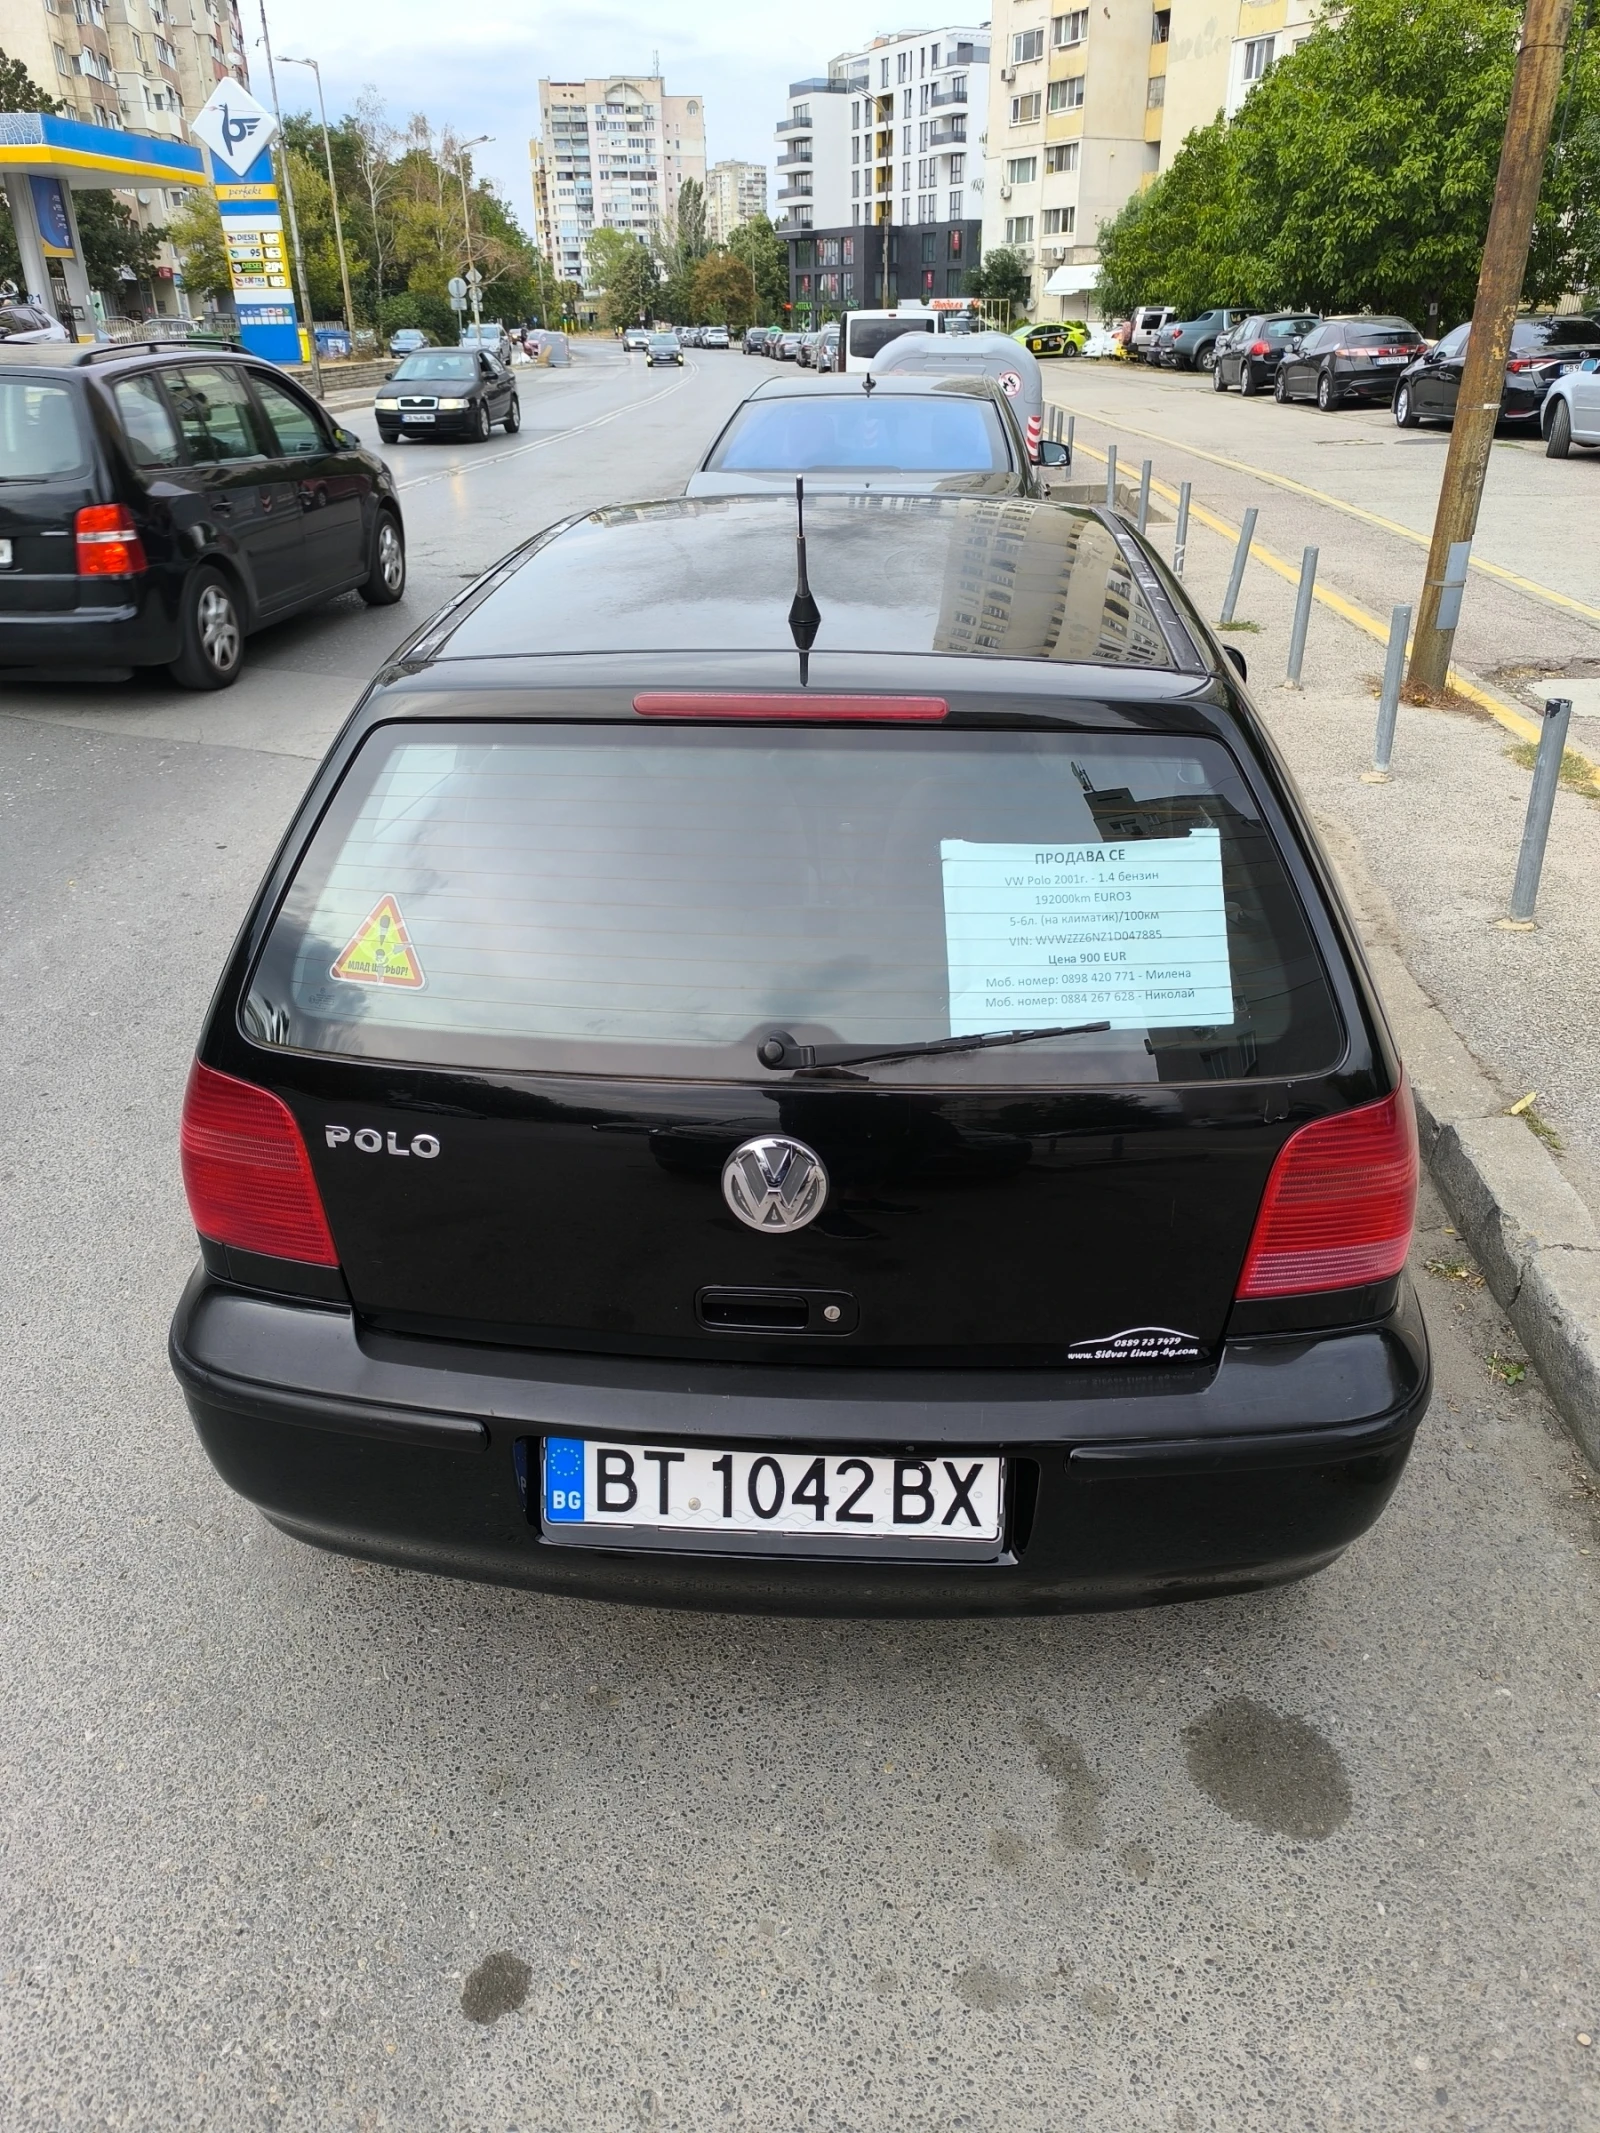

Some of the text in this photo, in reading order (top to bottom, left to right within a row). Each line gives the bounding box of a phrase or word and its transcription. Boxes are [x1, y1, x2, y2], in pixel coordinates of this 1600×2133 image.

[237, 233, 258, 241] DIESEL
[250, 248, 261, 257] 95
[241, 262, 263, 270] DIESEL
[244, 276, 265, 284] EXTRA
[1034, 848, 1126, 866] ПРОДАВА СЕ
[1004, 876, 1024, 887] VW
[1027, 874, 1052, 886] Polo
[1054, 873, 1088, 885] 2001г.
[1098, 872, 1116, 883] 1.4
[1118, 870, 1160, 882] бензин
[1035, 891, 1132, 905] 192000km EURO3
[1009, 910, 1160, 927] 5-6л. (на климатик)/100км
[1009, 936, 1033, 947] VIN:
[1048, 951, 1127, 966] Цена 900 EUR
[347, 960, 370, 973] МЛАД
[985, 976, 1015, 988] Моб.
[1018, 976, 1059, 987] номер:
[1061, 973, 1089, 984] 0898
[1090, 972, 1112, 983] 420
[1114, 971, 1135, 982] 771
[1145, 969, 1192, 980] Милена
[985, 996, 1014, 1008] Моб.
[1017, 996, 1058, 1007] номер:
[1060, 993, 1088, 1005] 0884
[1090, 992, 1111, 1003] 267
[1114, 991, 1135, 1002] 628
[1145, 987, 1196, 1000] Николай
[324, 1124, 441, 1159] POLO
[1114, 1337, 1182, 1347] 0889 73 7479
[597, 1448, 984, 1528] BT 1042 BX
[552, 1490, 581, 1510] BG
